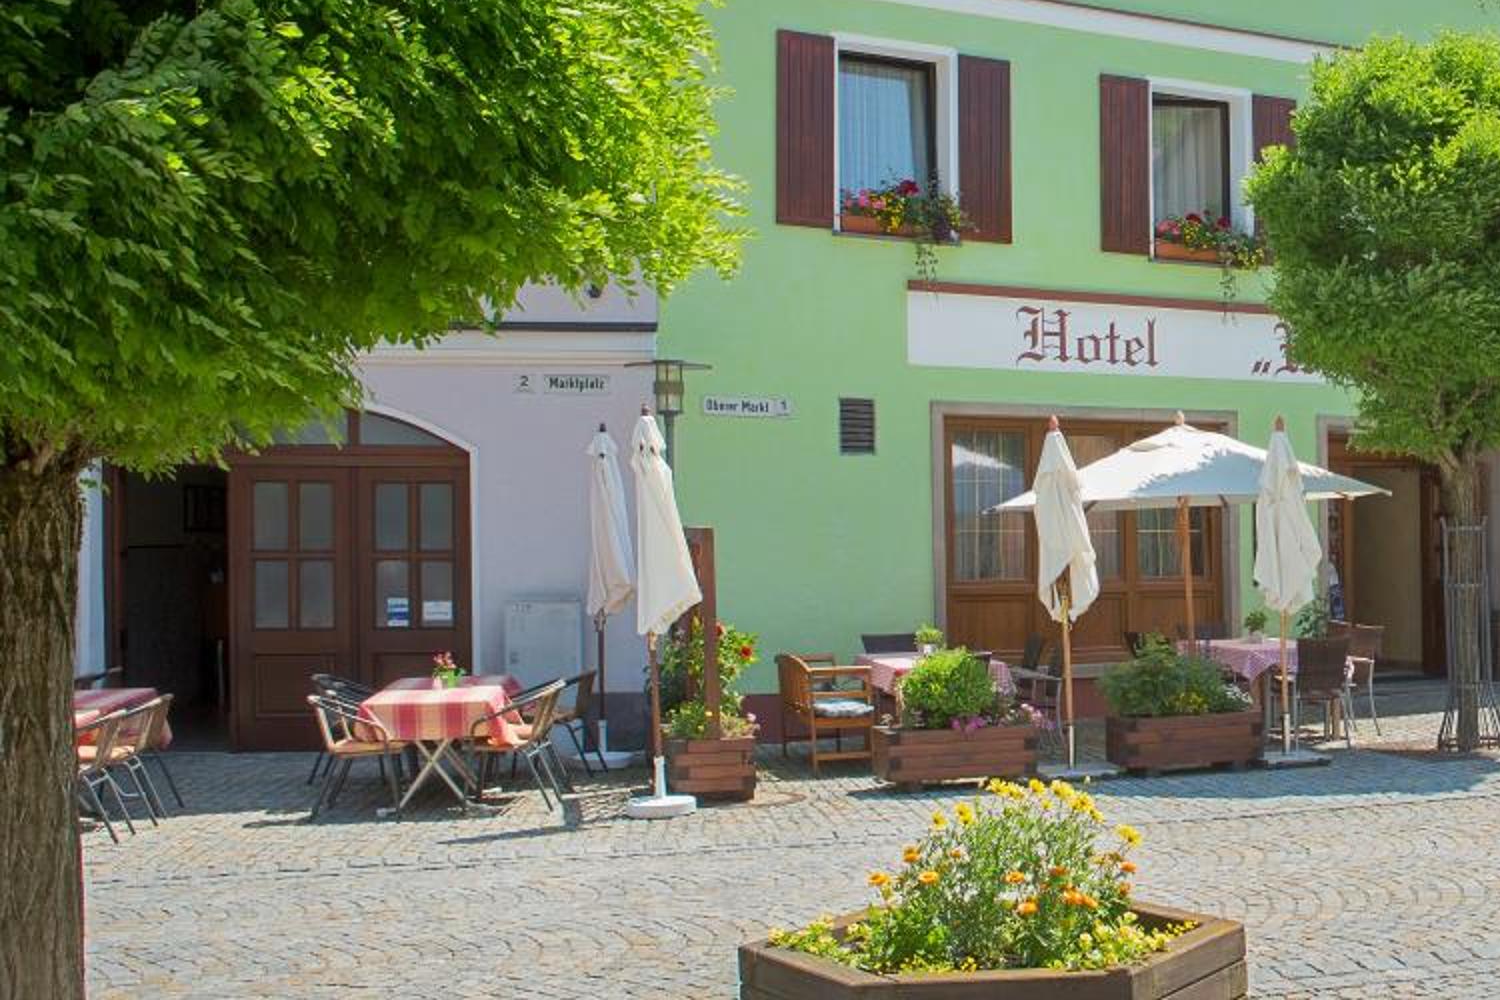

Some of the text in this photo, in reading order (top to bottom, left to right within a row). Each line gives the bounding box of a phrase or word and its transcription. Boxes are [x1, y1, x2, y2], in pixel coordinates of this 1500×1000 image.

[1016, 306, 1159, 367] Hotel
[519, 375, 529, 387] 2
[548, 376, 605, 392] Marktplatz
[705, 398, 738, 411] Oberer
[741, 399, 769, 413] Markt
